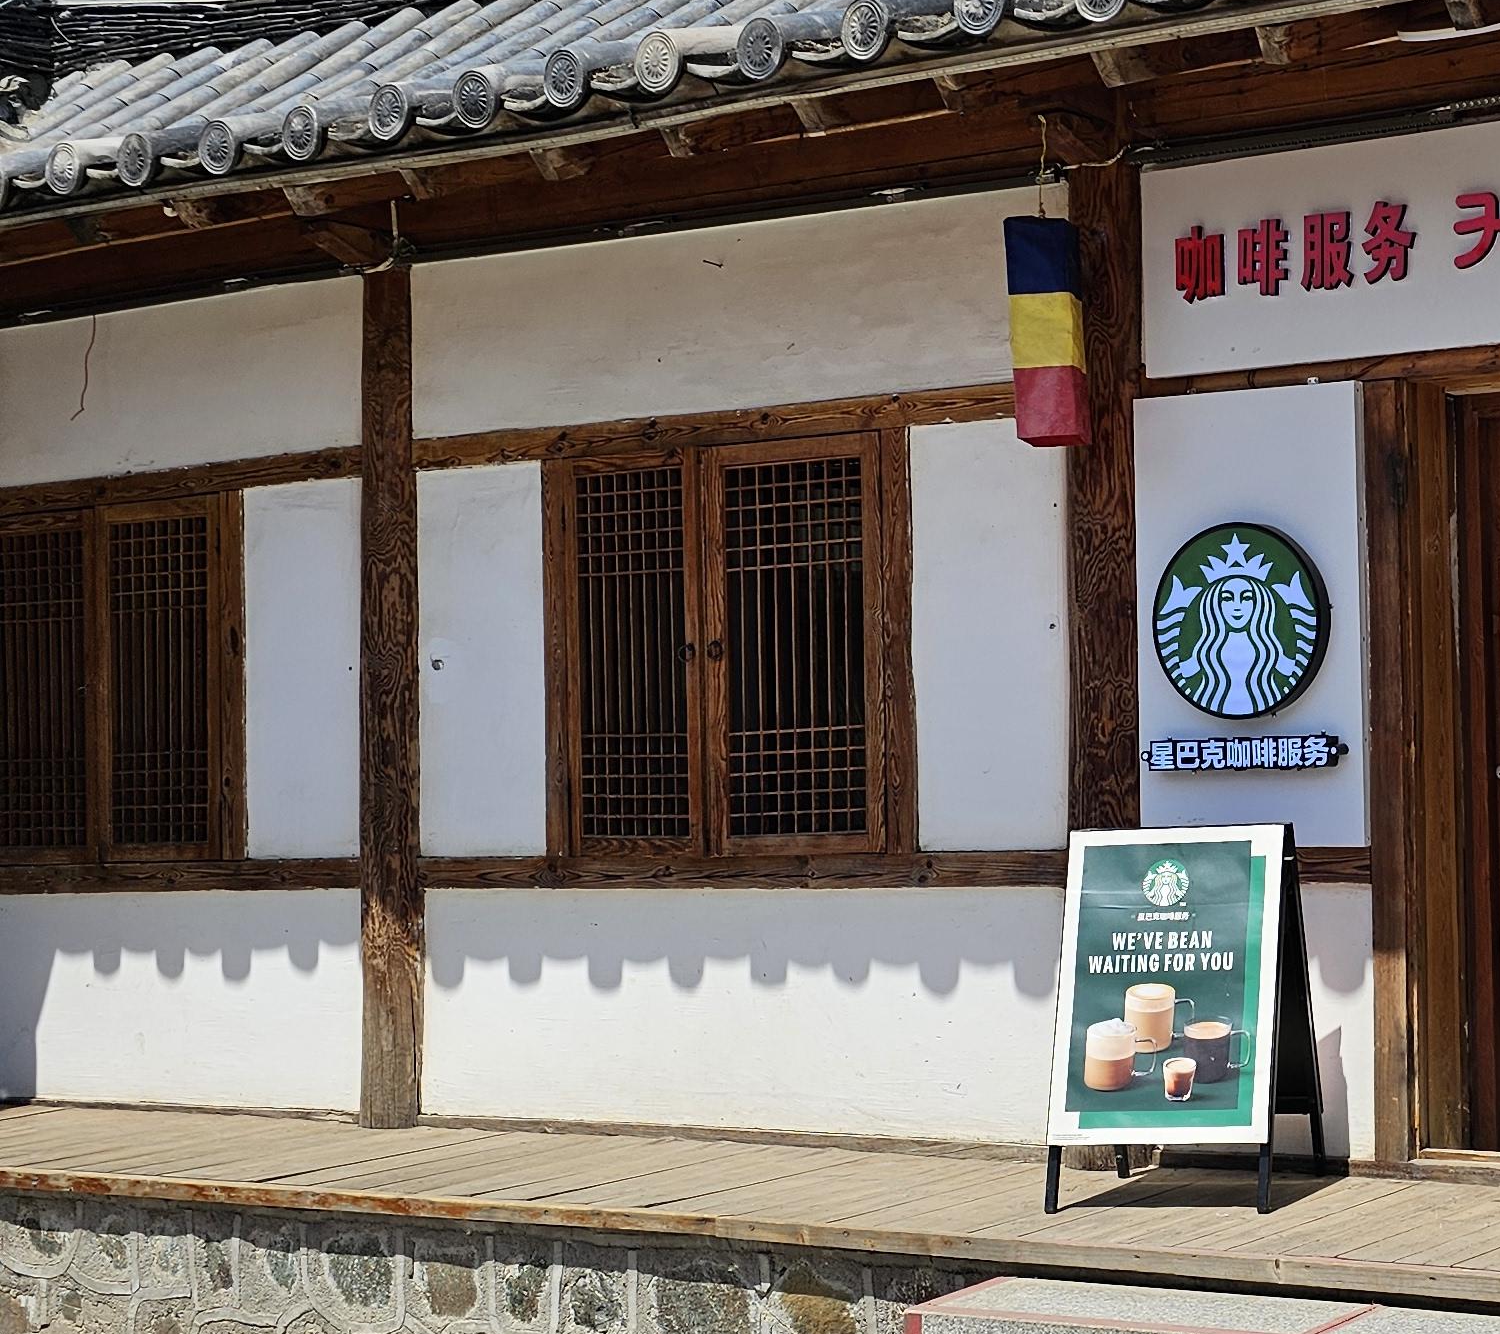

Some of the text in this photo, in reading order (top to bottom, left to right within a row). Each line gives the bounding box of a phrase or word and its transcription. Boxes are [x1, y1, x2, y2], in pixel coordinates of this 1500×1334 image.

[1176, 200, 1415, 301] 咖啡服务
[1150, 737, 1329, 770] 星巴克咖啡服务
[1112, 930, 1213, 951] WE'VE BEAN
[1088, 951, 1234, 974] WAITING FOR YOU
